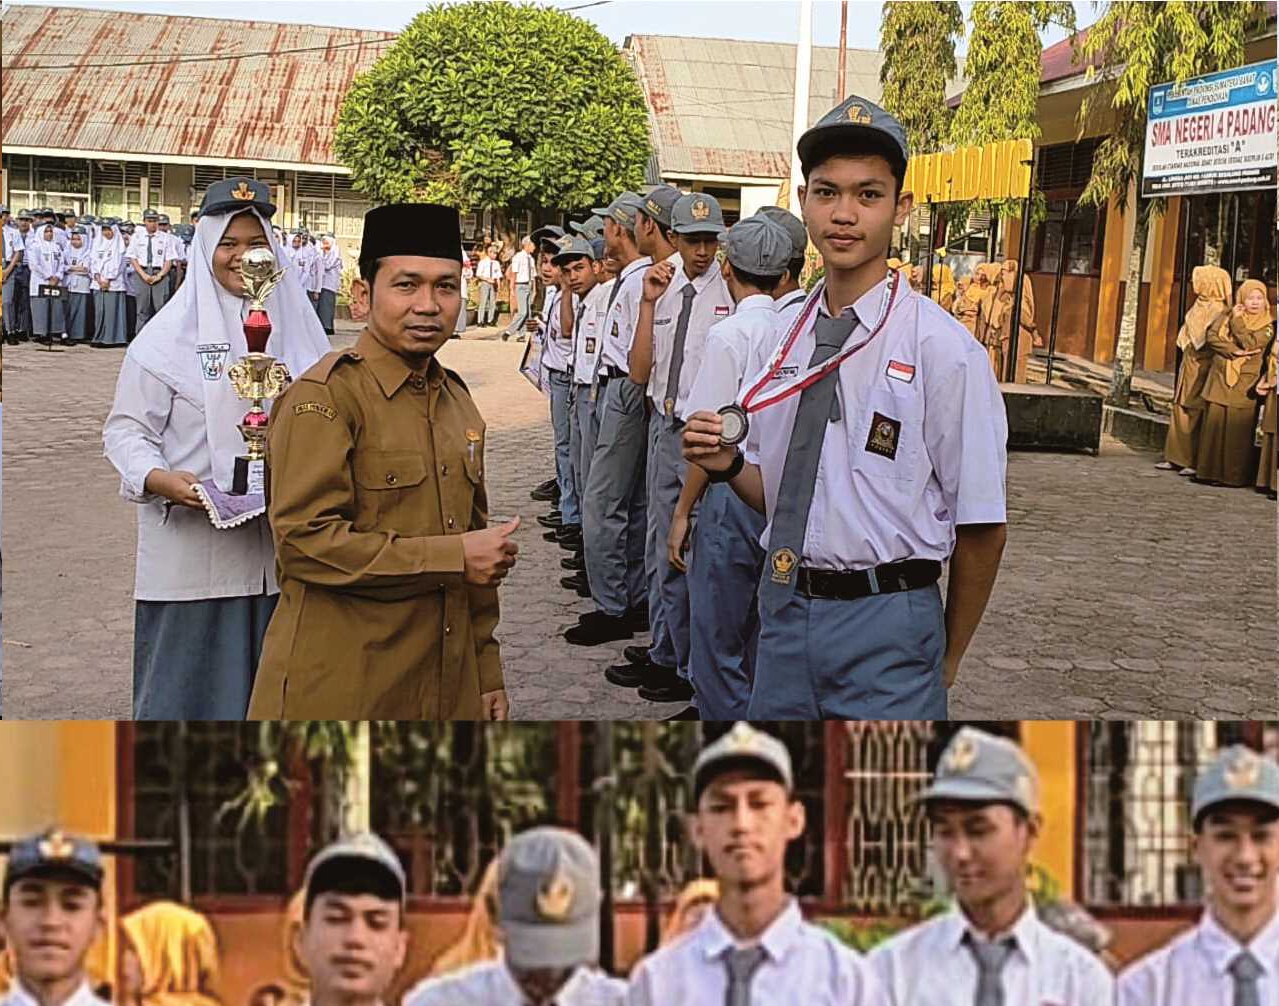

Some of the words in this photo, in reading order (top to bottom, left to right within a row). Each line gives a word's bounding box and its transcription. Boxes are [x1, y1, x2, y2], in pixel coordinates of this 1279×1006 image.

[1152, 121, 1171, 147] SMA
[1175, 114, 1215, 144] NEGERI
[1217, 112, 1224, 138] 4
[1227, 104, 1276, 137] PADANG
[1176, 144, 1230, 159] TERAKREDITASI
